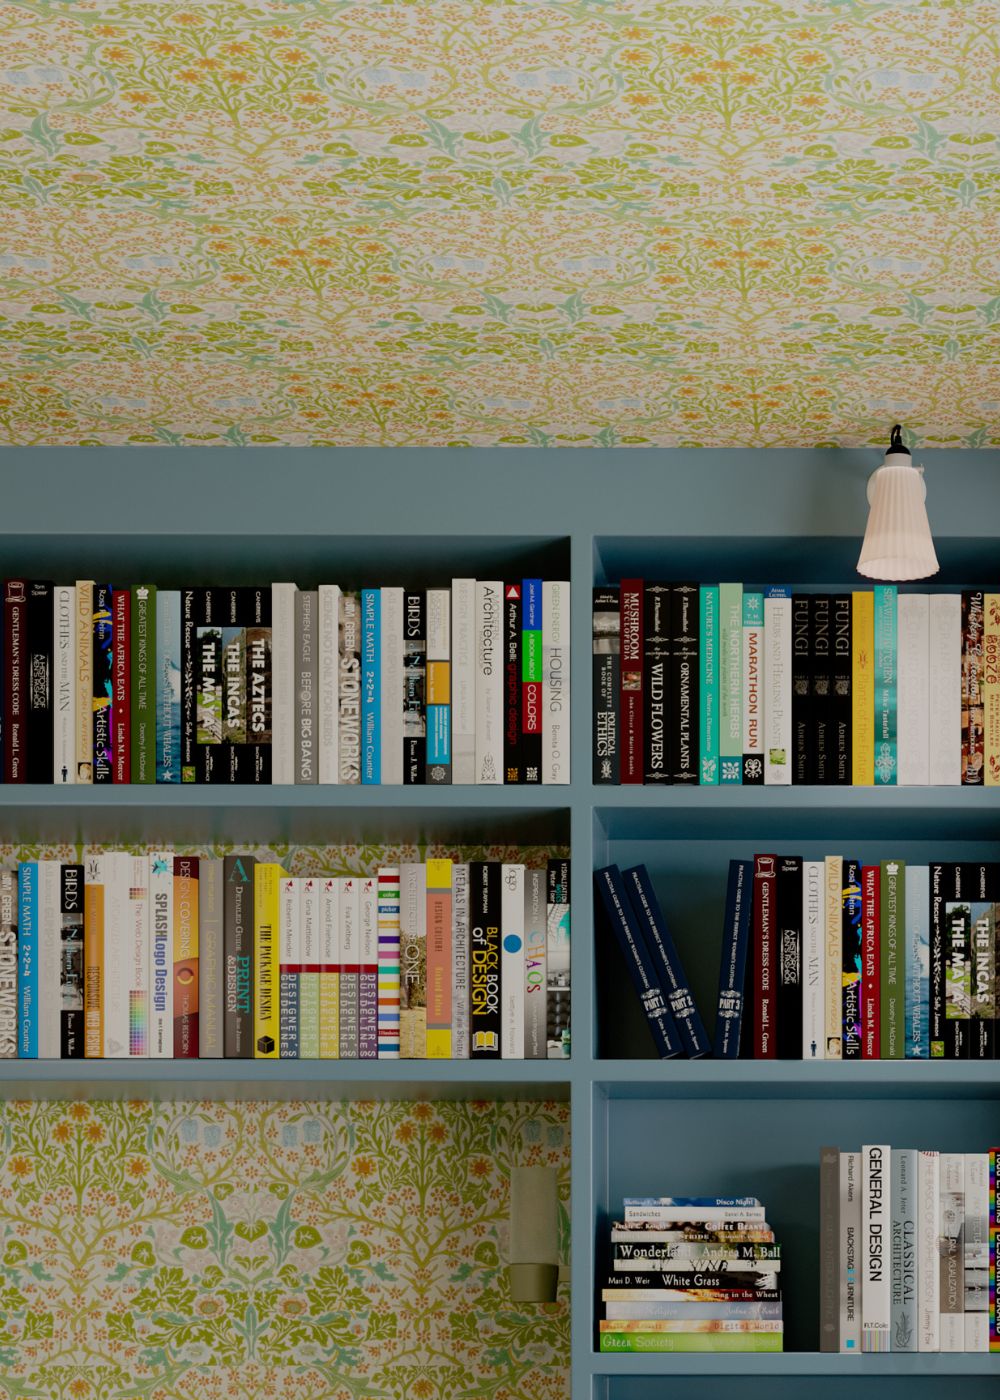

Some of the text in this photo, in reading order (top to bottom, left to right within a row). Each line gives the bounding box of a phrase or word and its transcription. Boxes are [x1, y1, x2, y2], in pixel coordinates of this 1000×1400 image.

[11, 607, 19, 664] GENTLEMAN'S
[59, 591, 69, 649] CLOTHES
[79, 584, 88, 682] WILD ANIMALS
[185, 591, 193, 648] Nature Rescue
[408, 596, 420, 636] BIRDS
[483, 587, 494, 676] Architecture
[630, 593, 639, 659] MUSHROOM
[795, 600, 808, 656] FUNGI
[815, 600, 828, 656] FUNGI
[836, 600, 849, 656] FUNGI
[11, 666, 19, 690] DRESS
[59, 682, 69, 711] MAN
[117, 595, 125, 780] WHAT THE AFRICA EATS Linda M. Mercer
[139, 664, 146, 674] OF
[202, 642, 215, 728] THE MAYA
[227, 643, 239, 728] THE INCAS
[252, 639, 264, 732] THE AZTECS
[366, 594, 374, 779] SIMPLE MATH 2+2=4 William Counter
[507, 603, 518, 744] Arthur A. graphic design
[549, 648, 562, 712] HOUSING
[730, 604, 739, 738] THE NORTHERN HERBS
[749, 633, 757, 714] MARATHON
[11, 693, 19, 715] CODE
[11, 724, 19, 748] Ronald
[301, 672, 311, 780] BEFORE BIG BANG!
[340, 657, 359, 780] STONEWORKS
[527, 684, 536, 730] COLORS
[597, 712, 607, 756] ETHICS
[607, 711, 615, 756] POLITICAL
[651, 664, 663, 768] WILD FLOWERS
[680, 663, 689, 768] ORNAMENTAL PLANTS
[749, 720, 757, 748] RUN
[11, 758, 19, 777] Green
[96, 706, 108, 779] Artistic Skills
[179, 861, 190, 958] DESIGN COVERING
[505, 868, 520, 891] logo
[455, 868, 465, 990] METALS IN ARCHITECTURE
[761, 882, 769, 990] GENTLEMAN'S DRESS CODE
[952, 918, 964, 1002] THE MAYA
[976, 918, 988, 1002] THE INCAS
[154, 970, 168, 1011] Design
[227, 956, 236, 1013] &DESIGN
[236, 956, 250, 1013] PRINT
[259, 924, 271, 1020] THE PACKAGE DESIGN
[472, 927, 486, 1015] of DESIGN
[486, 927, 498, 1013] BLACK BOOK
[525, 932, 545, 993] CHAOS
[367, 975, 376, 1057] DESIGNER'S
[644, 996, 664, 1011] PART 1
[671, 996, 693, 1011] PART 2
[719, 999, 740, 1010] PART 3
[869, 1148, 882, 1281] GENERAL DESIGN
[662, 1274, 720, 1286] White Grass
[743, 1247, 756, 1258] M.
[760, 1247, 780, 1258] Ball
[893, 1221, 902, 1304] ARCHITECTURE
[903, 1221, 914, 1304] CLASSICAL
